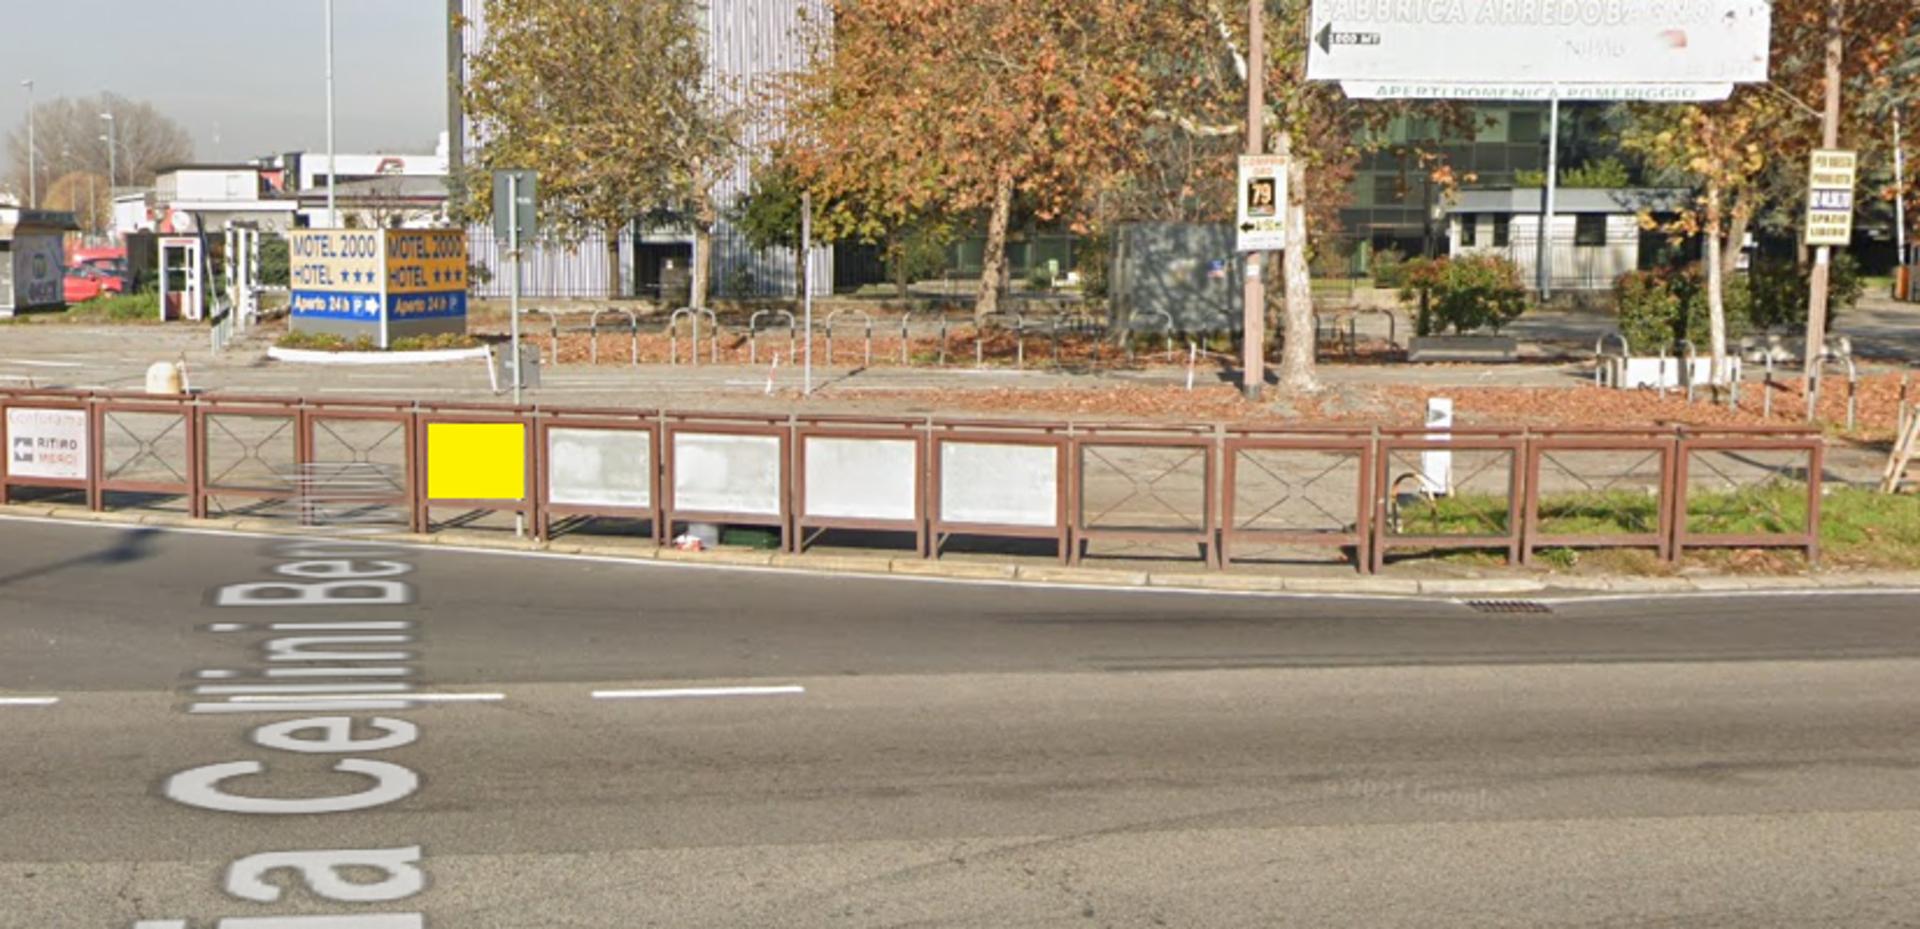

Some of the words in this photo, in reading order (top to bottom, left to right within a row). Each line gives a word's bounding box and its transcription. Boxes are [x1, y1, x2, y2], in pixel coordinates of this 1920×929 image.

[1375, 85, 1444, 97] APERTI
[1453, 87, 1559, 98] DOMENICA
[1567, 88, 1697, 99] POMERIGGIO
[1252, 183, 1271, 204] 79
[293, 235, 337, 258] MOTEL
[340, 234, 376, 258] 2000
[388, 235, 431, 259] MOTEL
[432, 234, 462, 259] 2000
[293, 264, 334, 285] HOTEL
[390, 265, 428, 287] HOTEL
[294, 295, 327, 312] Aperto
[395, 297, 425, 315] Aperto
